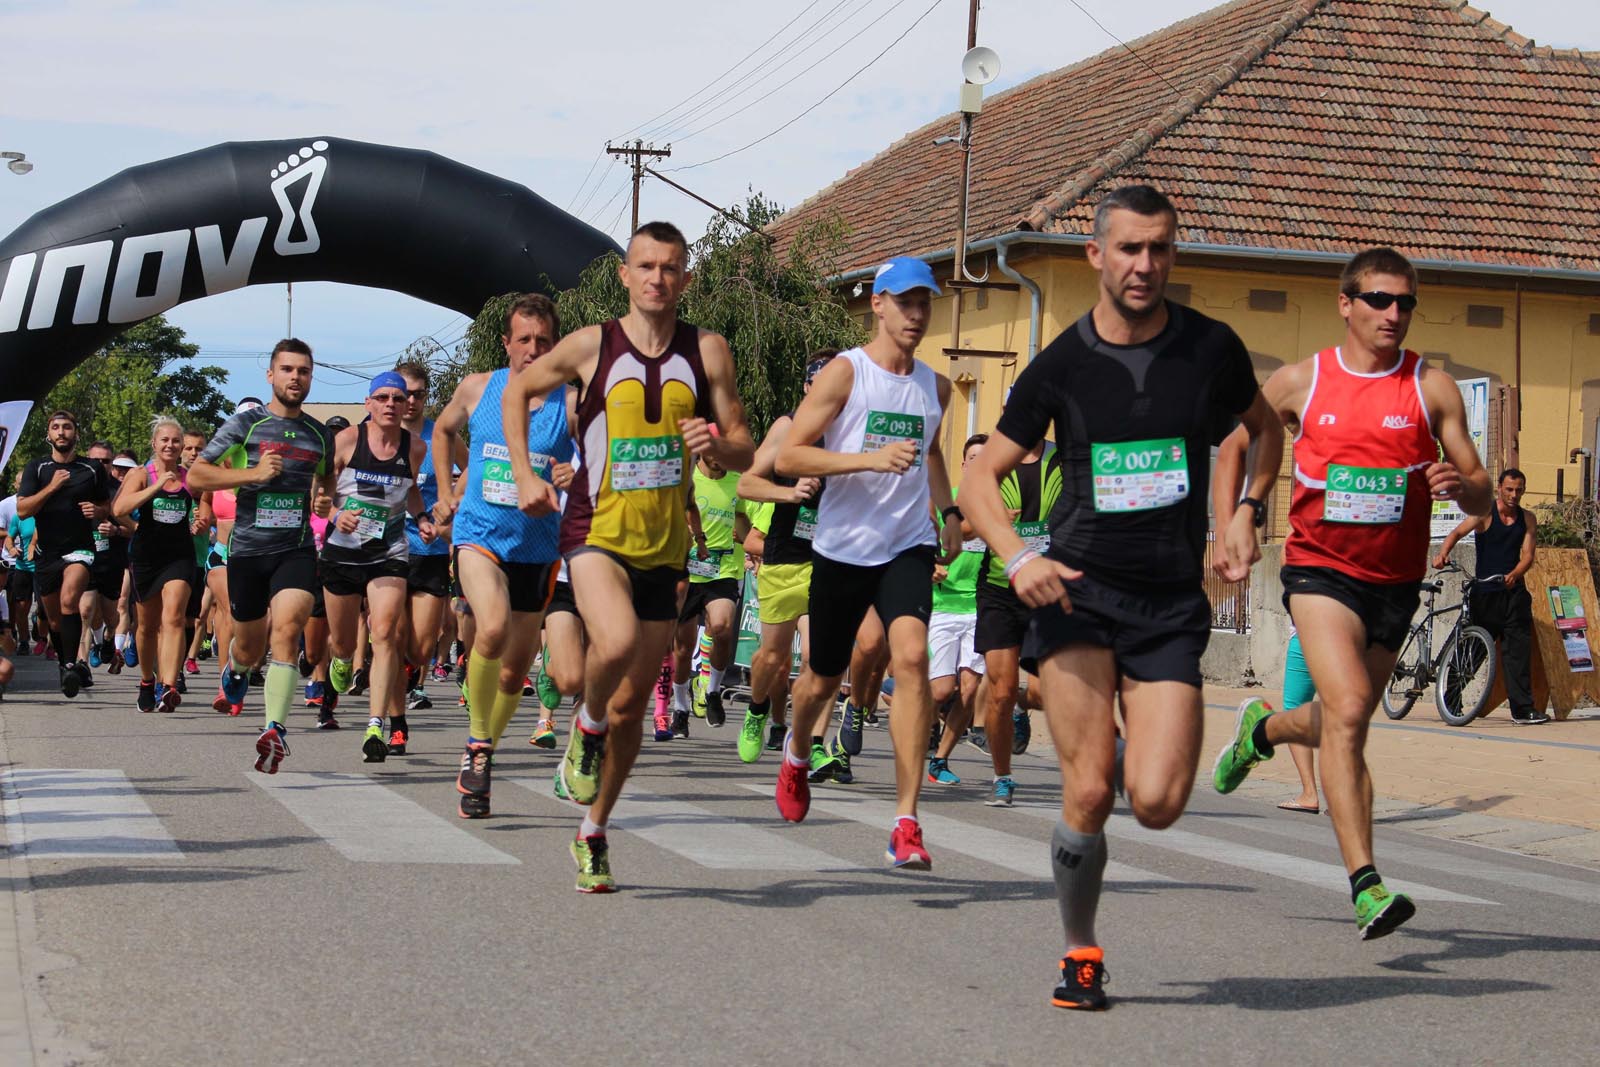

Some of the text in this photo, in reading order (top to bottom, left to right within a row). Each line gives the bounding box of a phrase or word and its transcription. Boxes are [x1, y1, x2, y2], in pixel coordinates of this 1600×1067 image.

[889, 420, 913, 435] 093
[638, 443, 667, 459] 090
[1125, 450, 1163, 470] 007
[1355, 475, 1387, 491] 043
[275, 498, 294, 509] 009
[1021, 525, 1040, 536] 098
